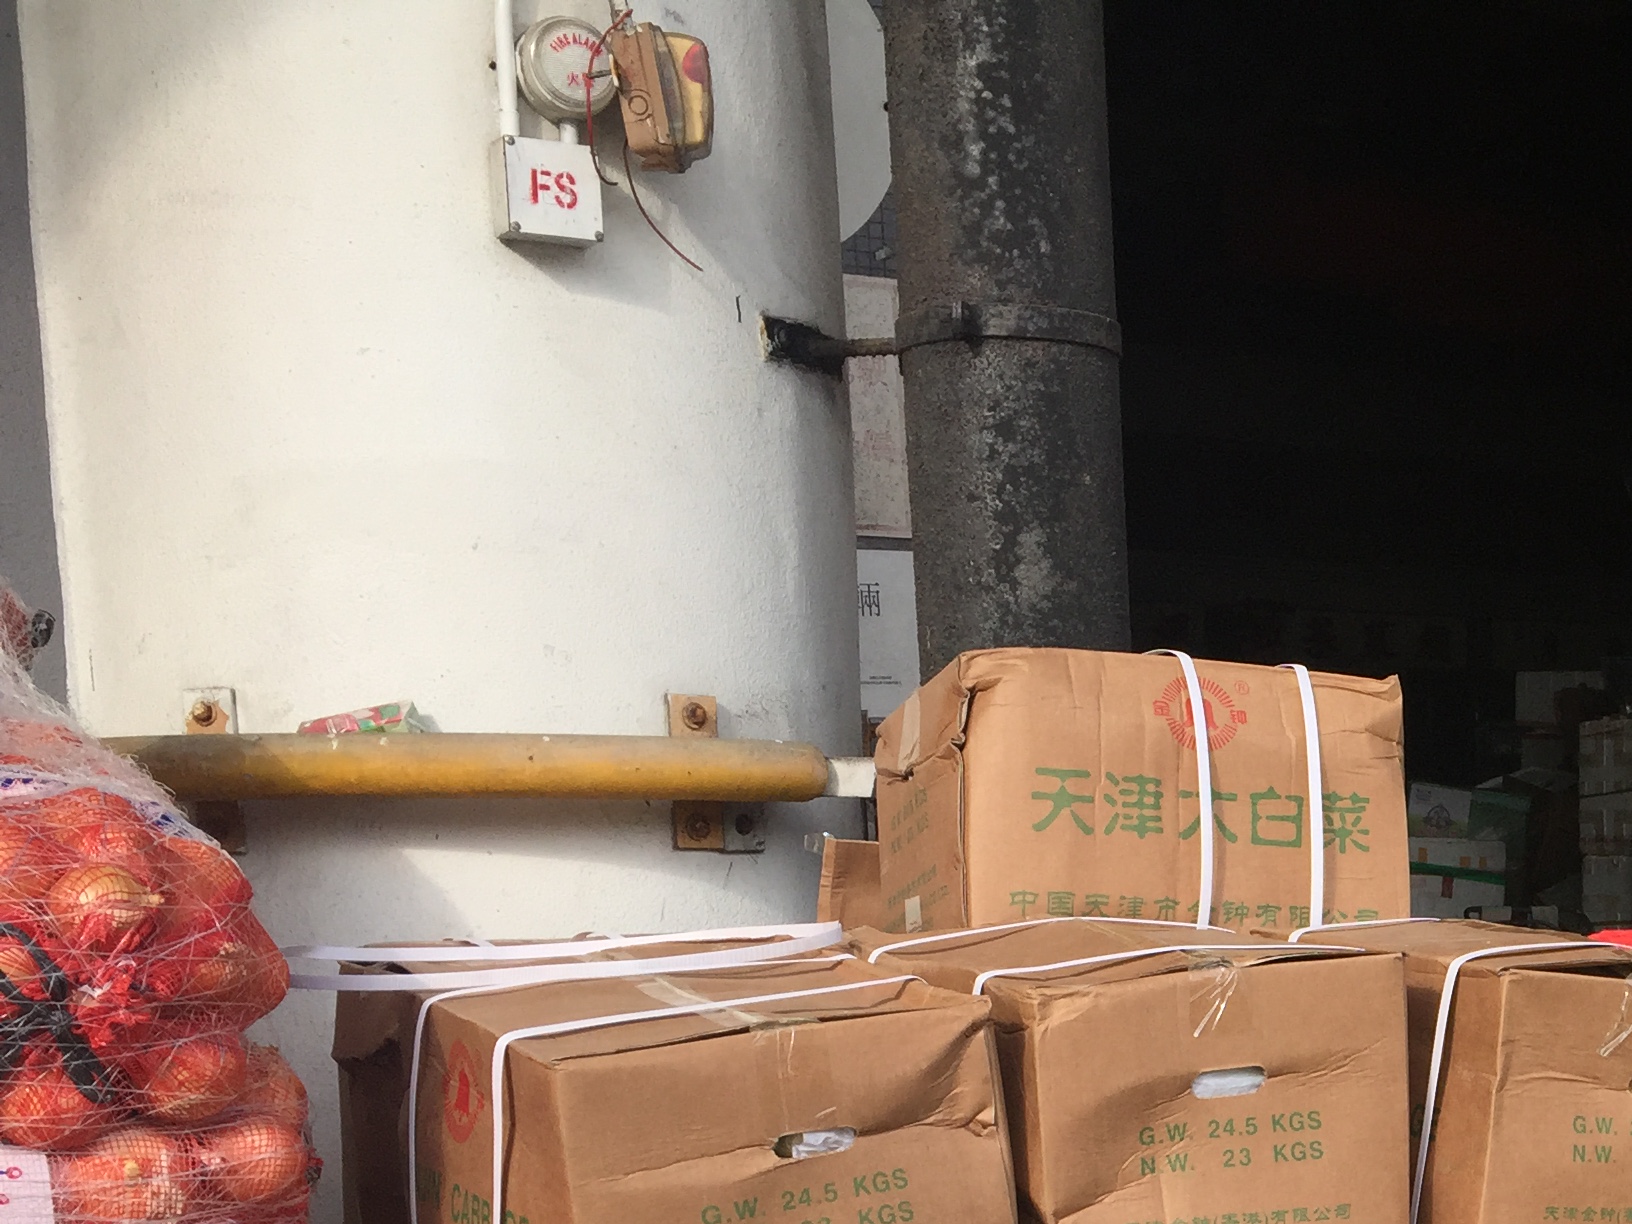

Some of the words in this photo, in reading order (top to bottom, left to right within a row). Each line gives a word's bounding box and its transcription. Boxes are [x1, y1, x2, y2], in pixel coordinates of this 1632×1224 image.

[550, 33, 571, 53] FIRE
[530, 168, 578, 209] FS
[1031, 767, 1370, 854] 天津大白菜
[1139, 1122, 1193, 1146] G.W.
[1209, 1116, 1258, 1139] 24.5
[1271, 1111, 1322, 1133] KGS
[1572, 1115, 1618, 1136] G.W.
[1140, 1153, 1194, 1176] N.W.
[1223, 1147, 1252, 1168] 23
[1273, 1141, 1324, 1162] KGS
[1572, 1145, 1617, 1164] N.W.
[781, 1183, 838, 1211] 24.5
[853, 1168, 909, 1198] KGS
